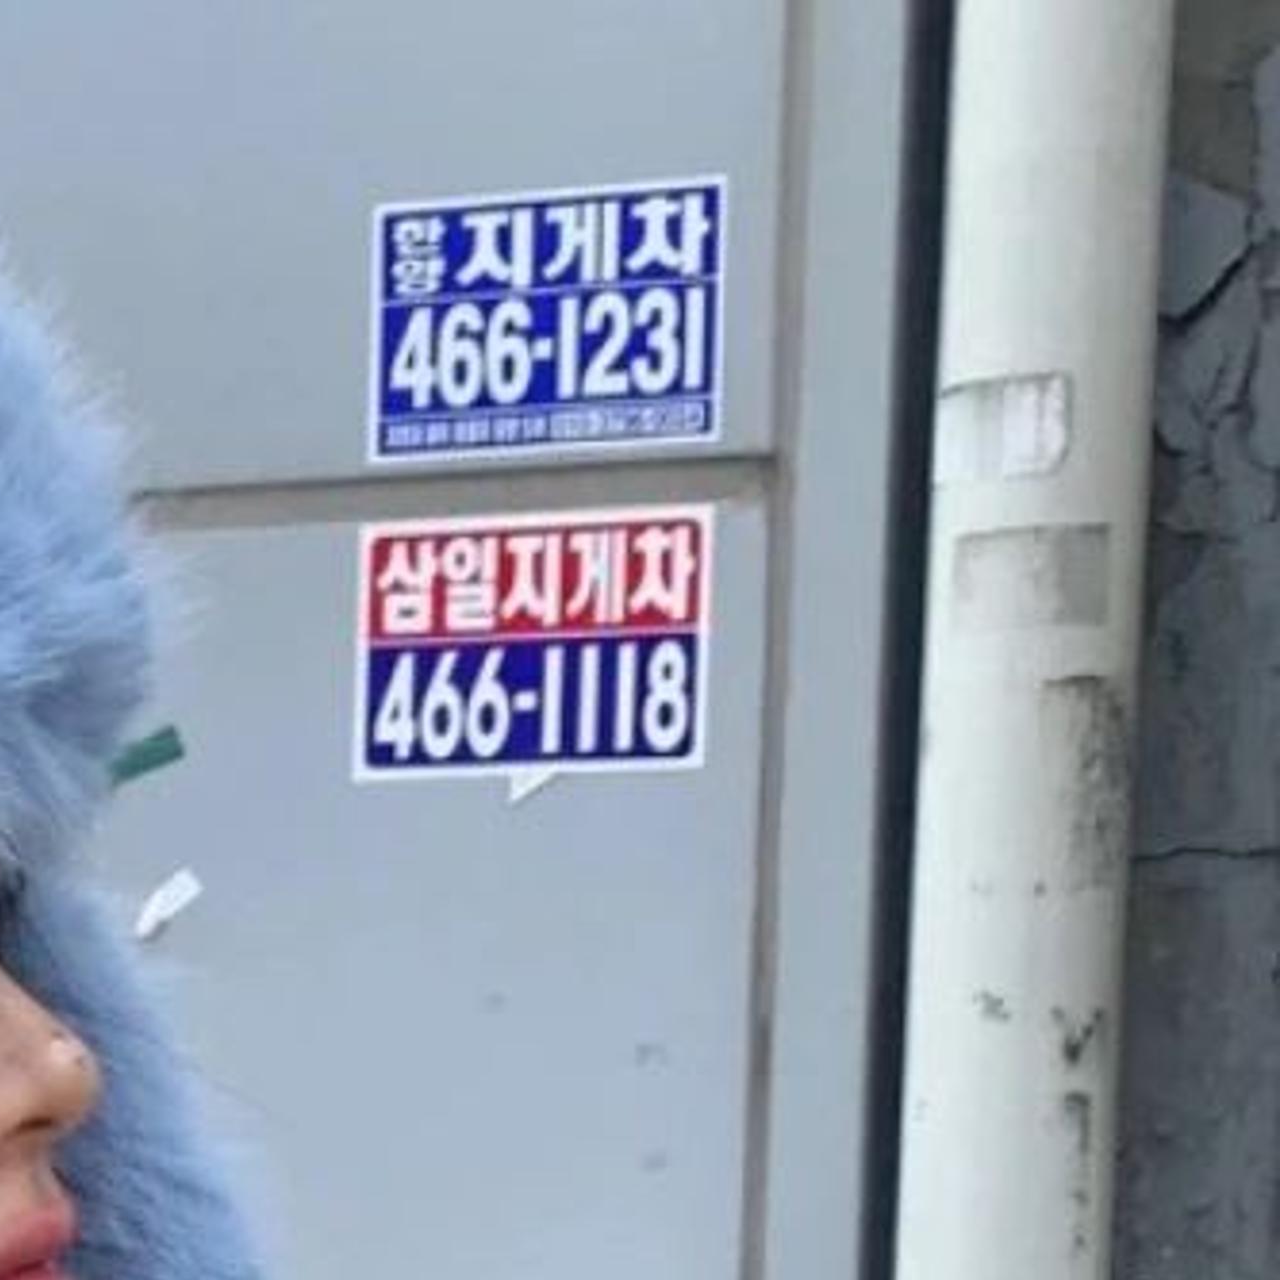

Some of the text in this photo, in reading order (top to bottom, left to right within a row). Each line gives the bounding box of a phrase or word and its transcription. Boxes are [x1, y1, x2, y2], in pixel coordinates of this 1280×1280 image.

[455, 192, 710, 289] 지게차
[389, 285, 705, 410] 466-1231
[376, 525, 695, 634] 삼일지게차
[373, 640, 689, 760] 466-1118
